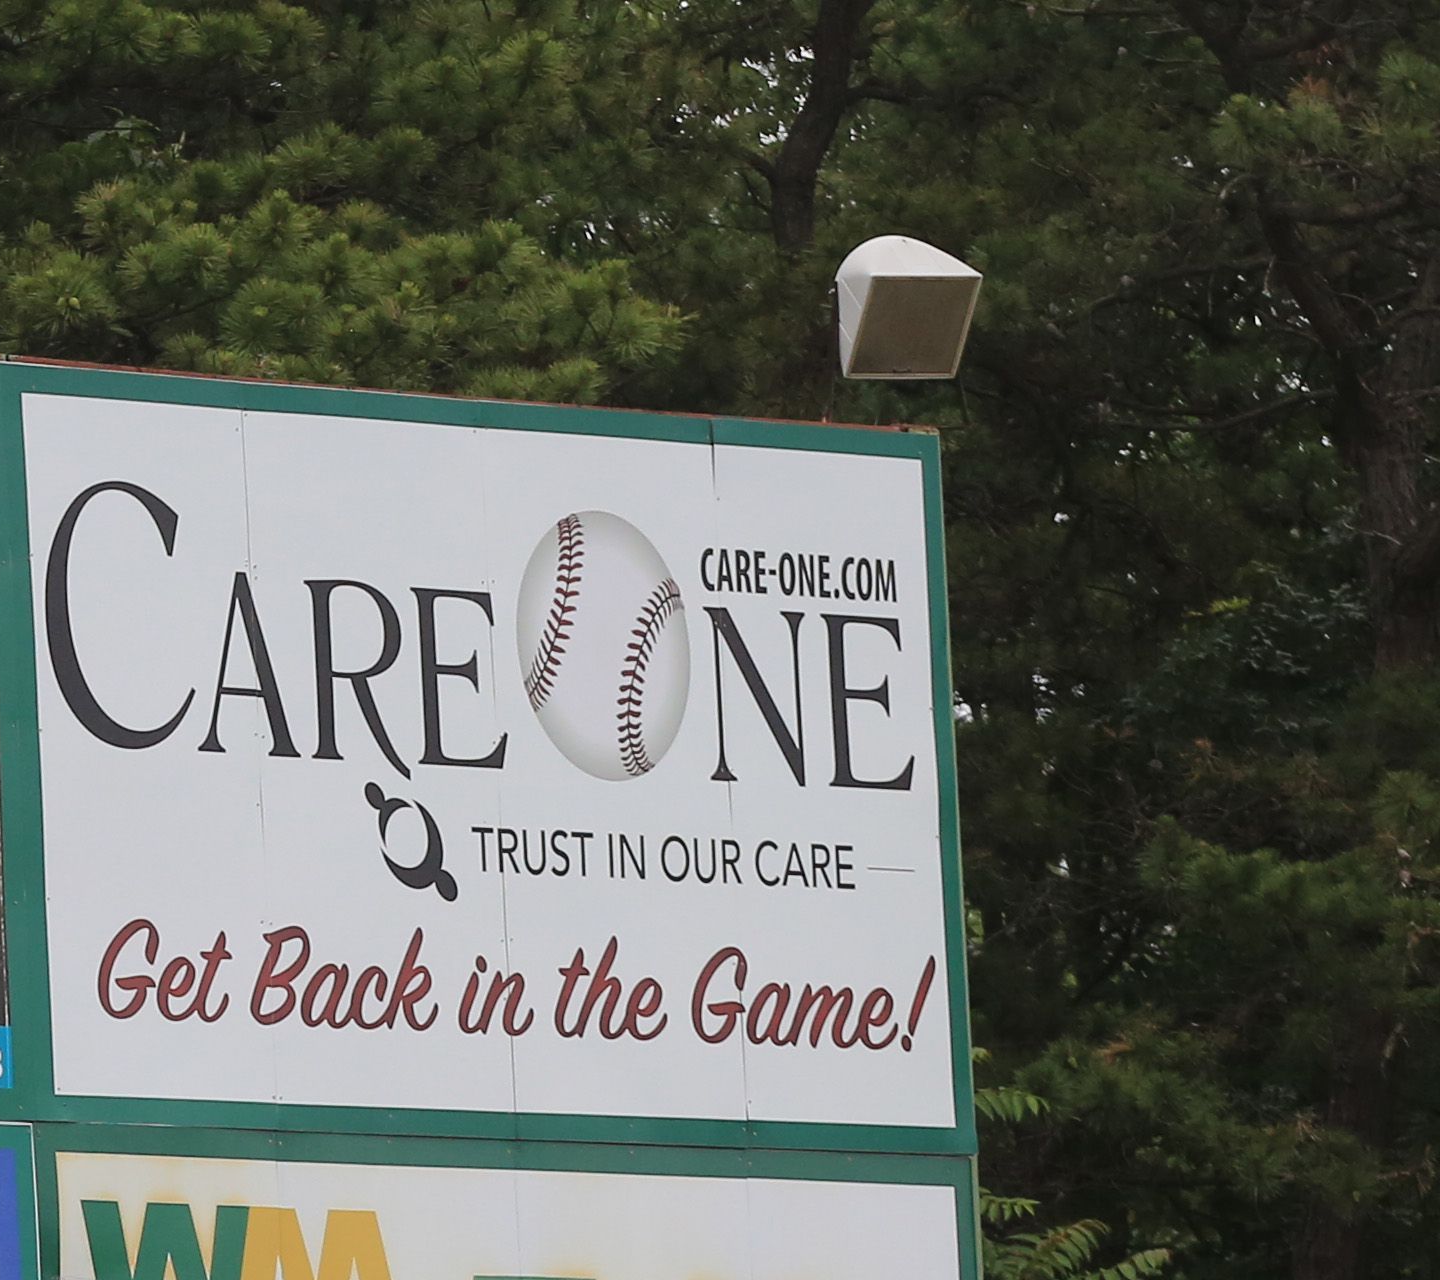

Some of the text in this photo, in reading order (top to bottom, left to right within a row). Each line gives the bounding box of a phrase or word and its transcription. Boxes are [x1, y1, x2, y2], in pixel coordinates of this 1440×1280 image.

[700, 547, 898, 602] CARE-ONE.COM
[471, 826, 857, 891] TRUST IN OUR CARE
[96, 917, 936, 1052] Get Back in the Game!
